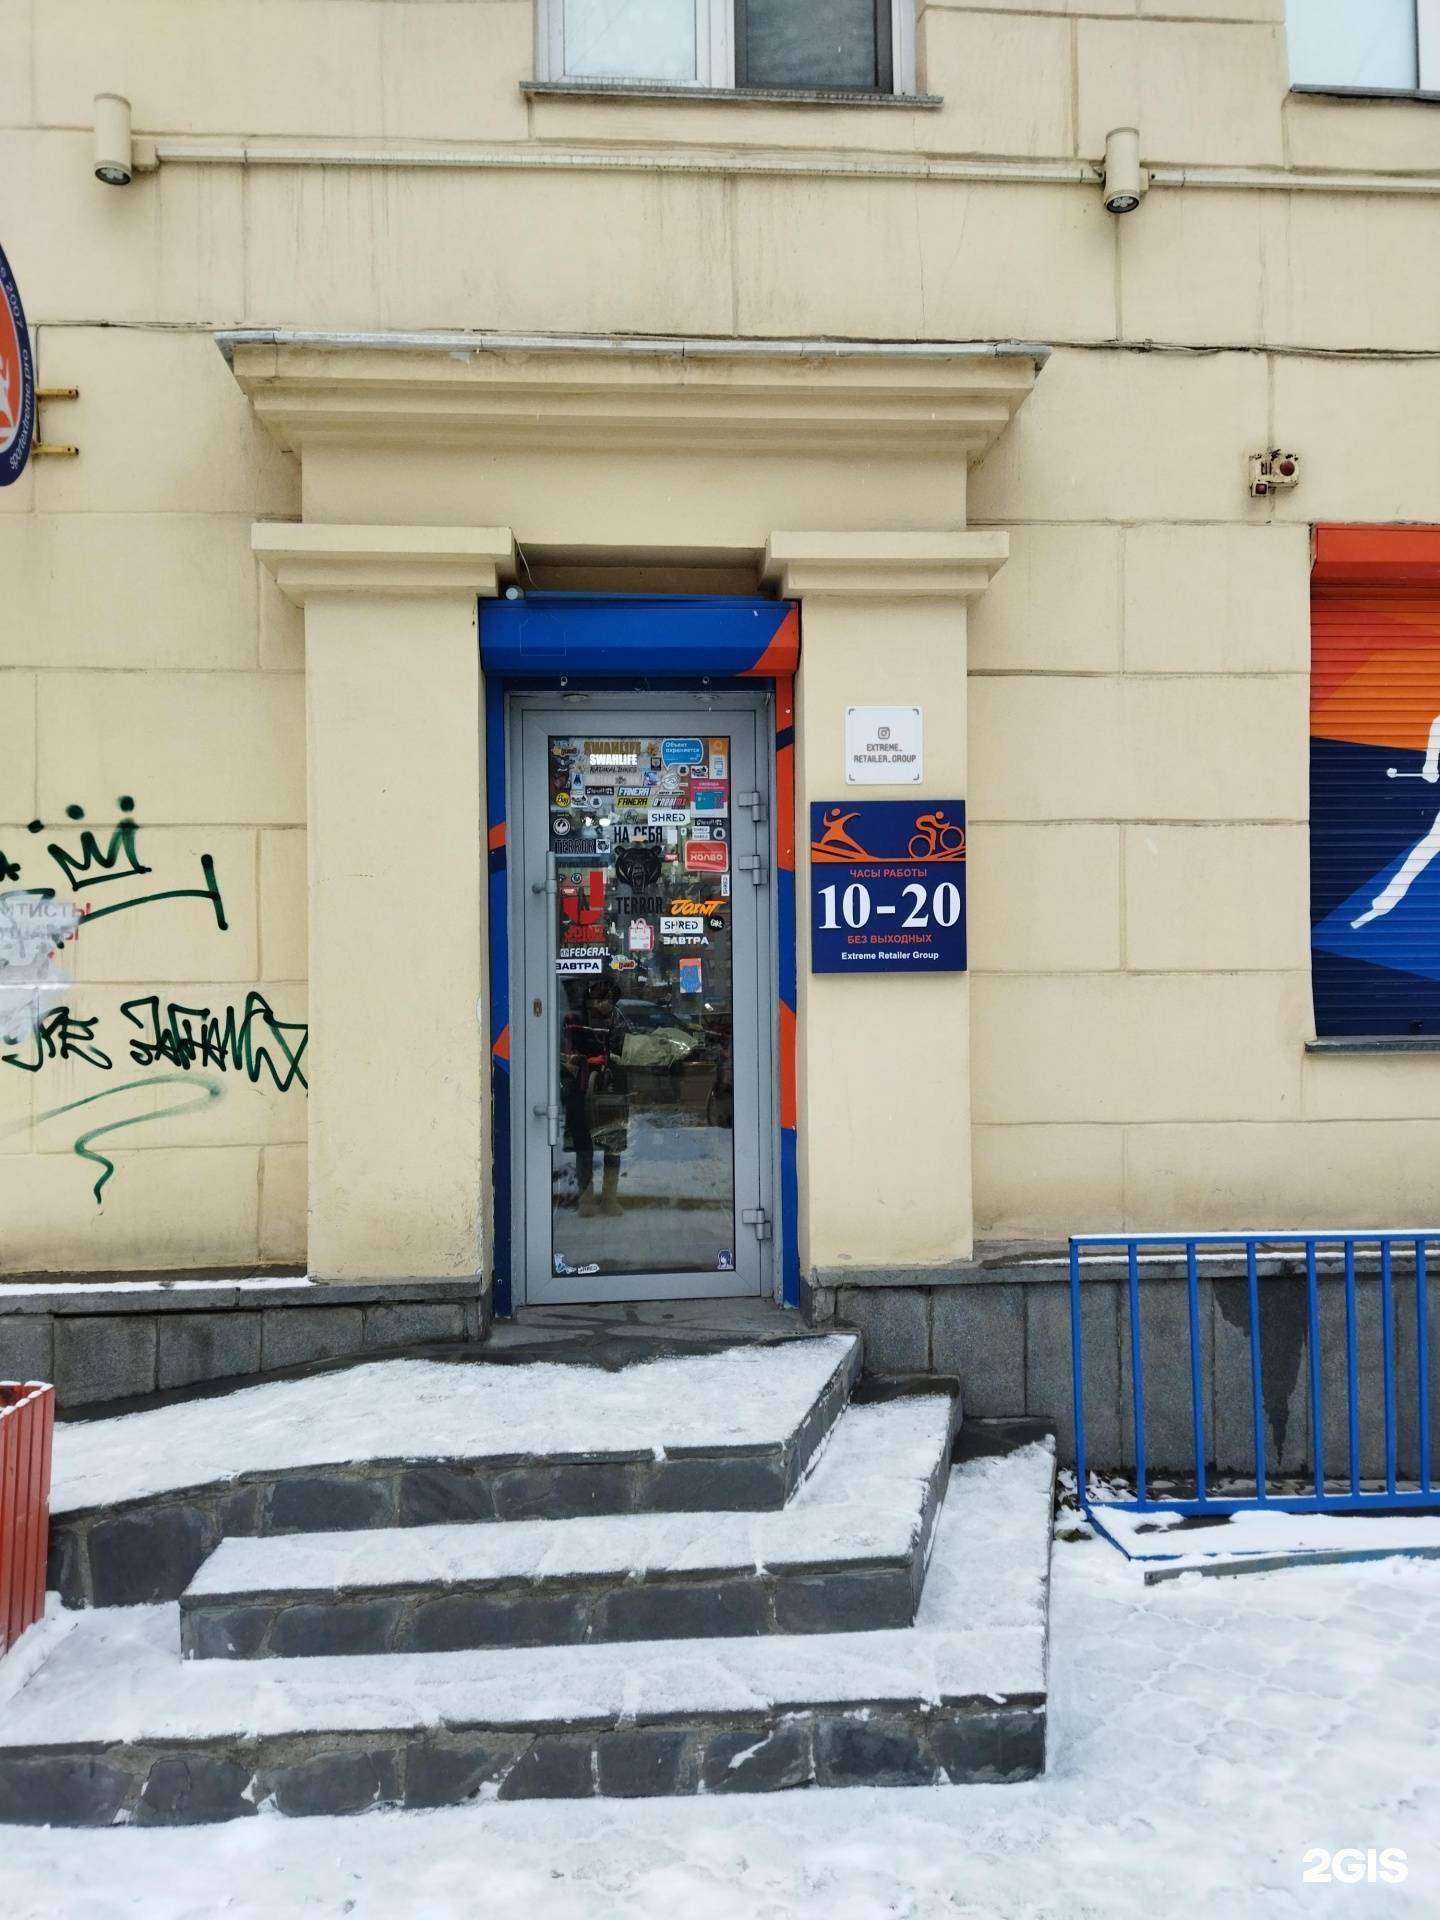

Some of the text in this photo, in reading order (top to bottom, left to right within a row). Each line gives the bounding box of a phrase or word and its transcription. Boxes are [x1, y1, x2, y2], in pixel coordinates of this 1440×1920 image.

[617, 797, 649, 806] FANERA
[651, 813, 686, 822] SHRED
[613, 826, 630, 843] НА
[850, 869, 928, 878] ЧАСЫ РАБОТЫ
[818, 882, 961, 929] 10-20
[664, 920, 699, 930] SHRED
[663, 936, 709, 945] ЗАВТРА
[847, 934, 933, 944] БЕЗ ВЫХОДНЫХ
[569, 947, 610, 957] FEDERAL
[841, 951, 939, 961] Extreme Retailer Group
[556, 962, 599, 970] ЗАВТРА
